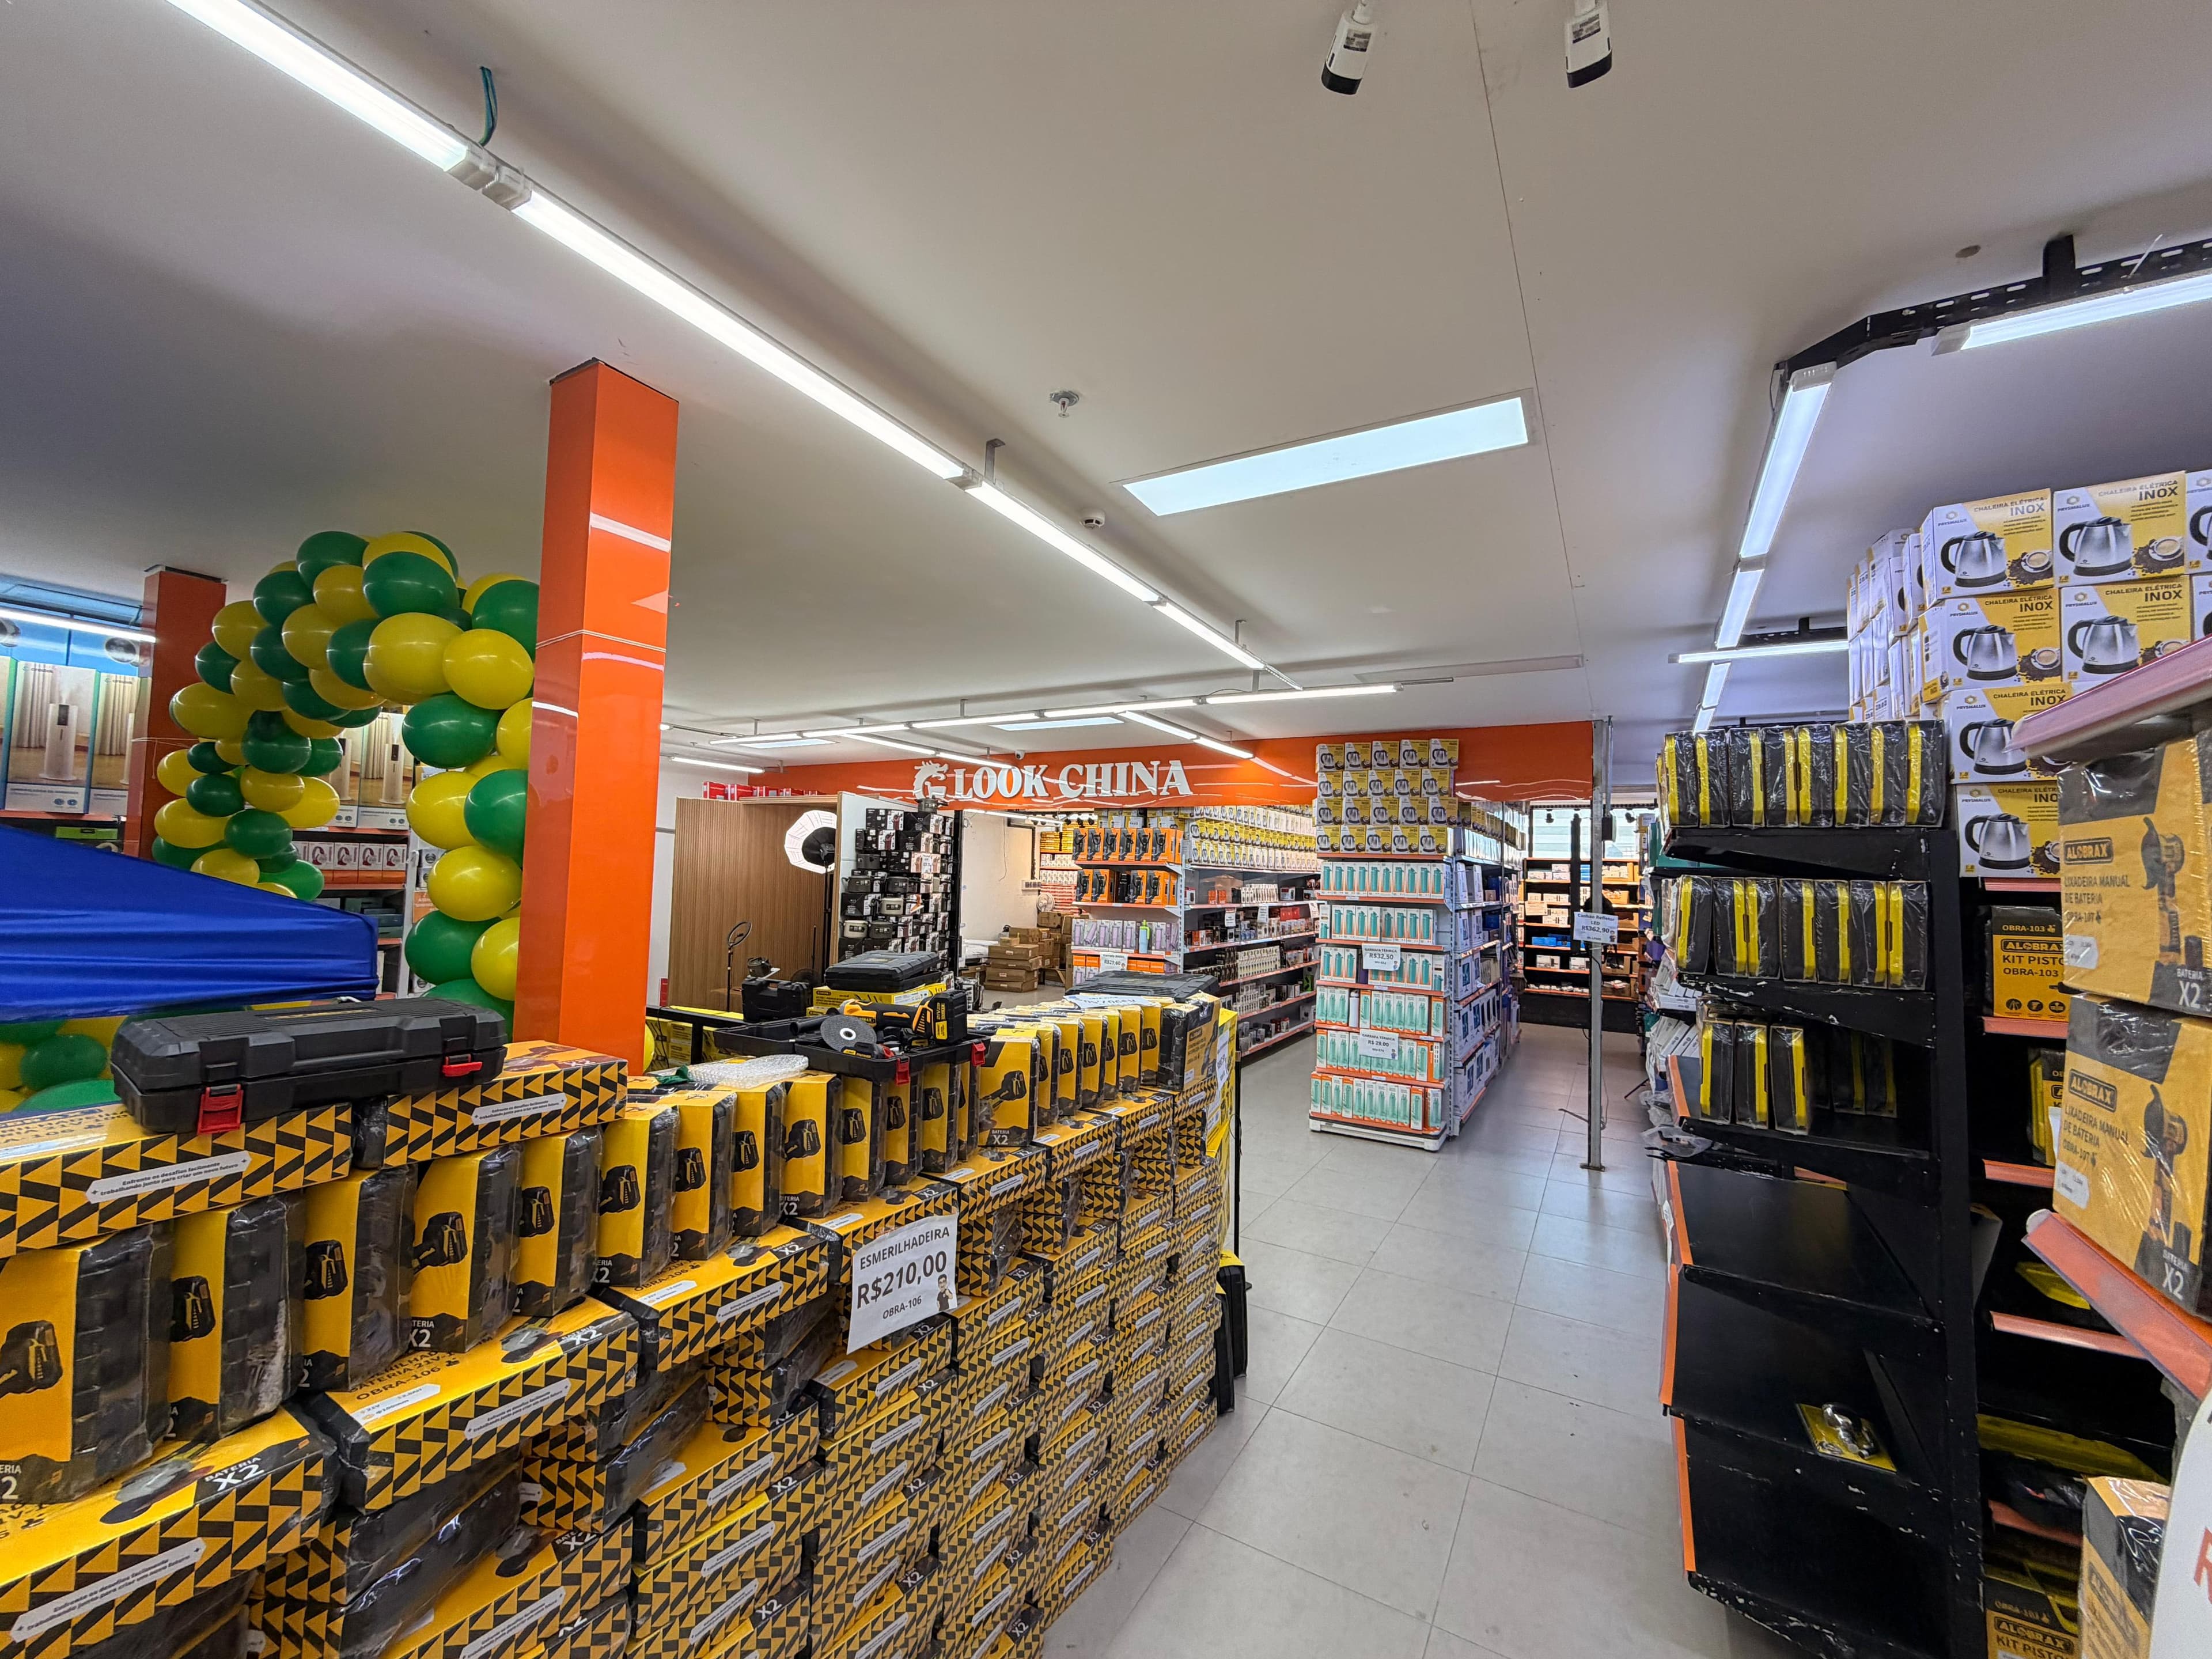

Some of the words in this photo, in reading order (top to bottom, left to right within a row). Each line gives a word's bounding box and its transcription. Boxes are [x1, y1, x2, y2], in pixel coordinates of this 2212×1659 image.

[2099, 487, 2137, 497] CHALEIRA
[2140, 480, 2178, 490] ELÉTRICA
[2139, 486, 2178, 501] INOX
[1974, 502, 2009, 513] CHALEIRA
[2010, 497, 2045, 506] ELÉTRICA
[2010, 503, 2045, 516] INOX
[2105, 587, 2143, 596] CHALEIRA
[2145, 584, 2183, 592] ELÉTRICA
[2145, 590, 2183, 602] INOX
[1985, 598, 2018, 606] CHALEIRA
[2020, 594, 2053, 603] ELÉTRICA
[2020, 601, 2053, 612] INOX
[2031, 695, 2066, 706] INOX
[953, 764, 1051, 798] LOOK
[1059, 760, 1193, 798] CHINA
[2035, 794, 2058, 802] INO
[2099, 875, 2130, 888] MANUAL
[2065, 893, 2073, 903] DE
[2074, 893, 2103, 904] BATERIA
[1582, 925, 1609, 933] R$362,90
[2003, 955, 2024, 964] KIT
[2028, 956, 2064, 965] PISTO
[2003, 968, 2059, 978] OBRA-103
[2177, 968, 2203, 980] BATERIA
[2179, 980, 2200, 1009] X2
[566, 1059, 596, 1067] X2
[2065, 1105, 2098, 1130] LIXADEIRA
[2099, 1119, 2129, 1146] MANUAL
[993, 1135, 1009, 1145] X2
[2074, 1127, 2100, 1148] BATERIA
[100, 1183, 142, 1196] trabalhando
[143, 1180, 160, 1188] junto
[220, 1163, 238, 1171] futuro
[122, 1176, 151, 1186] Enfrente
[161, 1169, 187, 1179] desafios
[188, 1162, 220, 1172] facilmente
[779, 1244, 804, 1255] X2
[860, 1226, 950, 1270] ESMERILHADEIRA
[634, 1269, 688, 1291] OBRA-106
[857, 1251, 946, 1309] R$210,00
[2162, 1262, 2183, 1300] X2
[882, 1296, 922, 1319] OBRA-106
[412, 1319, 434, 1328] TERIA
[914, 1325, 934, 1335] X2
[571, 1330, 603, 1346] X2
[356, 1367, 441, 1401] OBRA-106
[918, 1380, 938, 1392] X2
[0, 1464, 22, 1474] ERIA
[204, 1457, 262, 1482] BATERIA
[213, 1464, 264, 1491] X2
[772, 1476, 797, 1493] X2
[1007, 1472, 1024, 1484] X2
[1, 1476, 19, 1499] 2
[907, 1478, 926, 1493] X2
[1006, 1550, 1022, 1563] X2
[903, 1571, 924, 1588] X2
[756, 1599, 782, 1620] X2
[1012, 1622, 1029, 1637] X2
[1996, 1635, 2018, 1652] KIT
